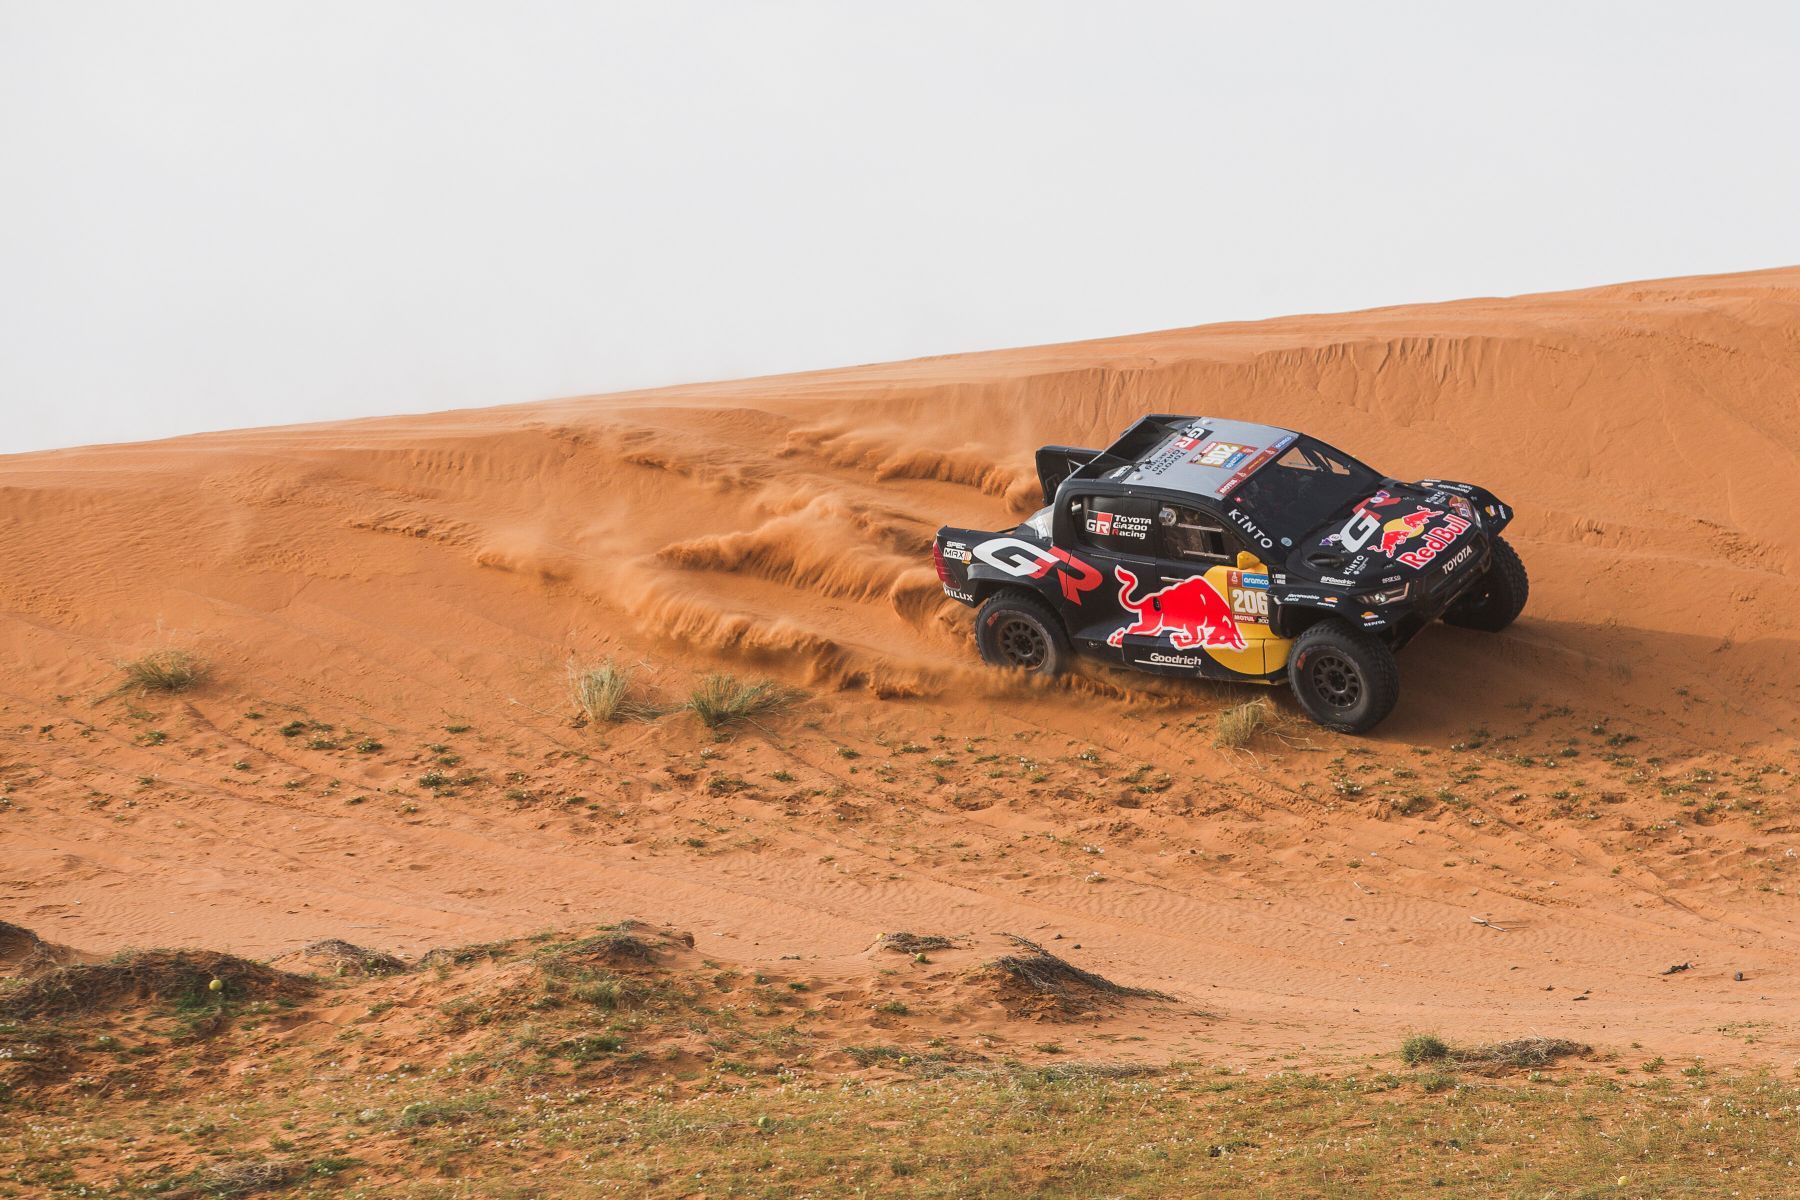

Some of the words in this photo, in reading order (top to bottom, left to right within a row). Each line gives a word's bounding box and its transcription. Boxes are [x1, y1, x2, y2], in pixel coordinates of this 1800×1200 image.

[1114, 514, 1152, 525] TOYOTA
[1086, 519, 1110, 534] GR
[1112, 521, 1148, 532] GAZOO
[1112, 529, 1146, 540] Racing
[1442, 545, 1473, 575] TOYOTA
[1243, 577, 1269, 586] aramco
[944, 587, 974, 602] HILUX
[1232, 589, 1269, 615] 206
[1150, 652, 1202, 665] Goodrich
